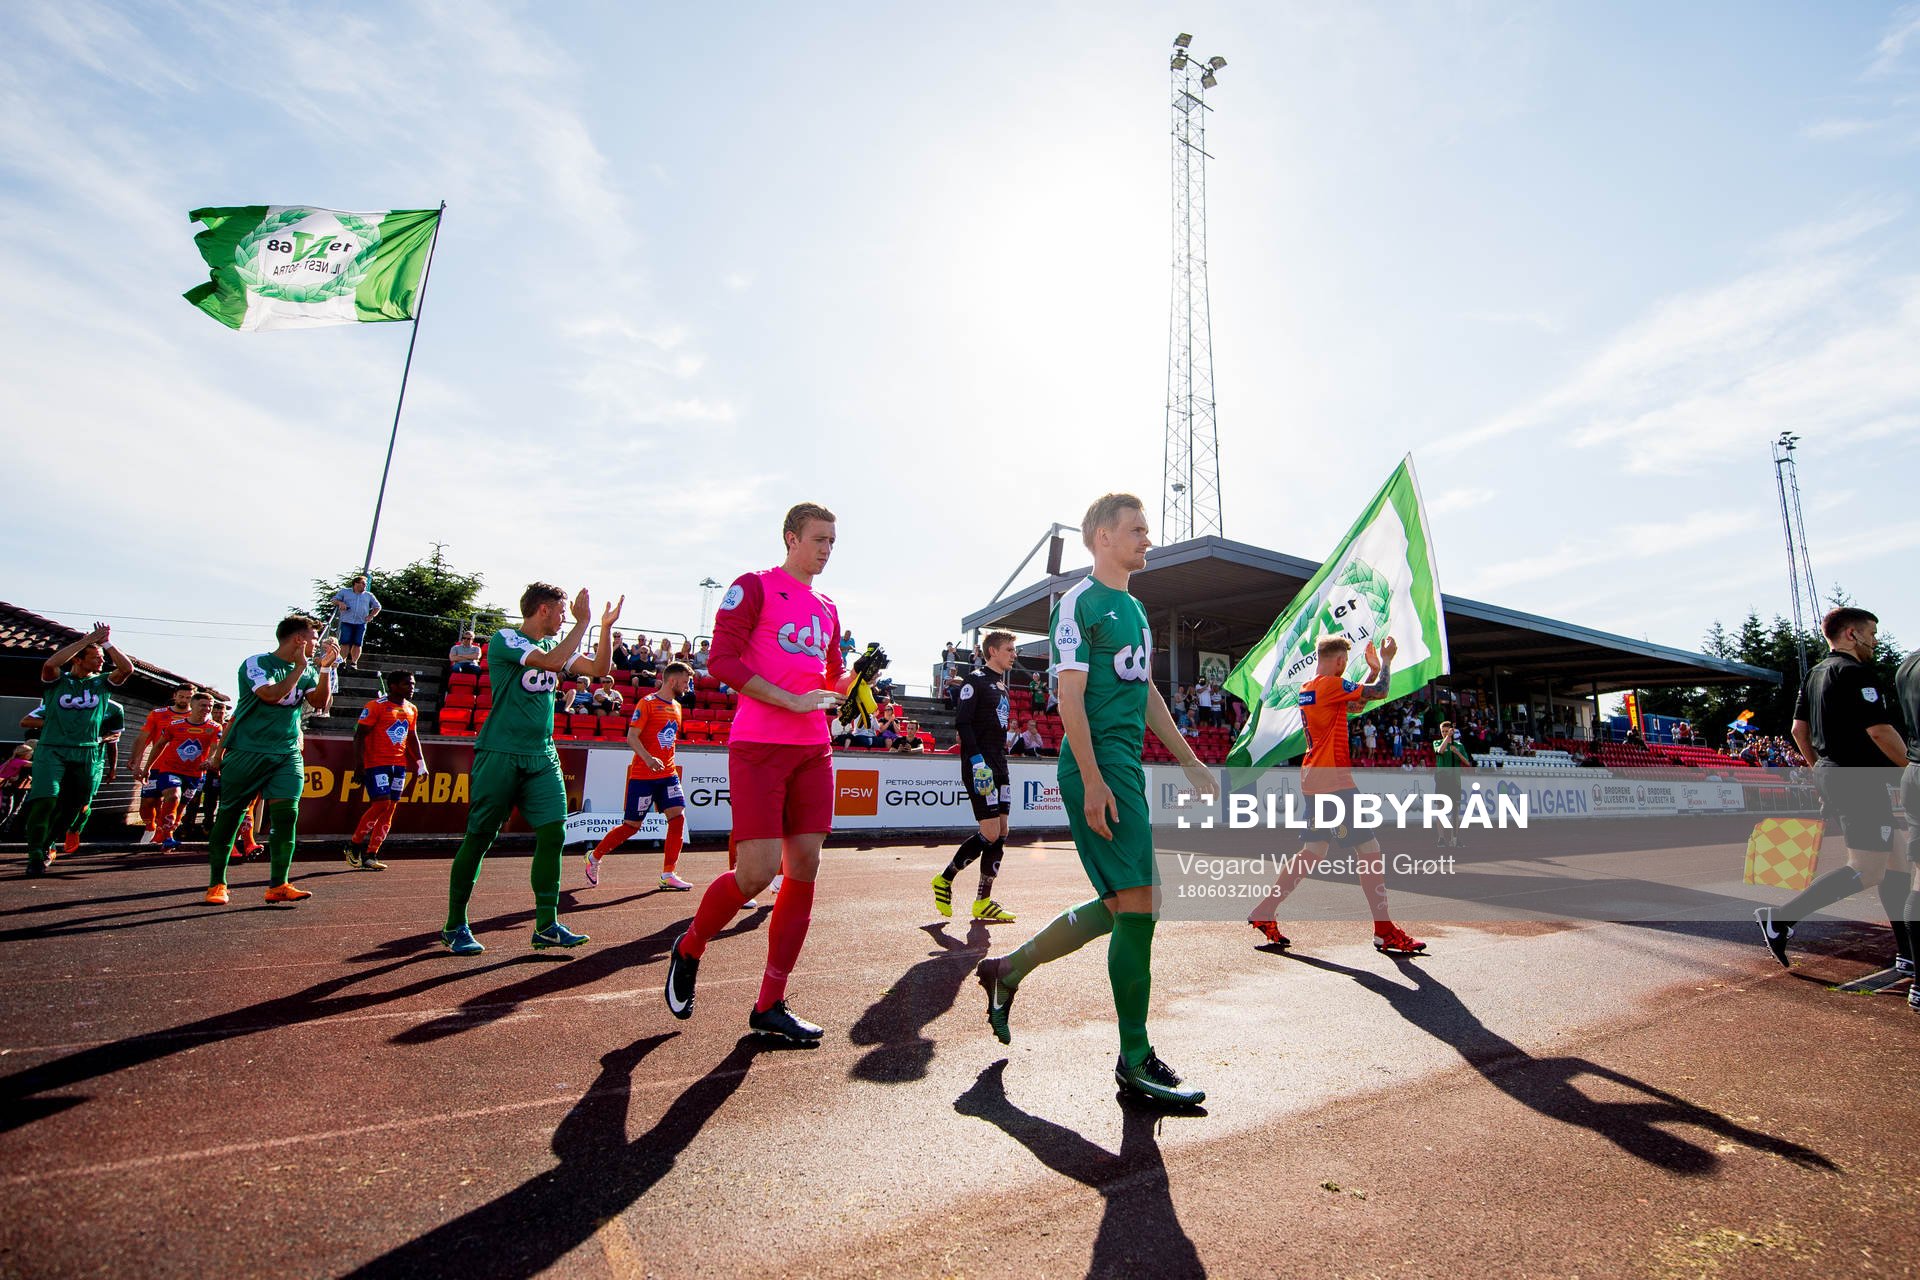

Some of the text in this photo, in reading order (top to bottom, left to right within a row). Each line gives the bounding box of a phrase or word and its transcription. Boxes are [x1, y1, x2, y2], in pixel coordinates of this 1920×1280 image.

[1057, 637, 1078, 645] OBOS
[690, 776, 727, 784] PETRO
[840, 787, 873, 798] PSW
[885, 790, 970, 806] GROUP
[1528, 789, 1588, 814] LIGAEN
